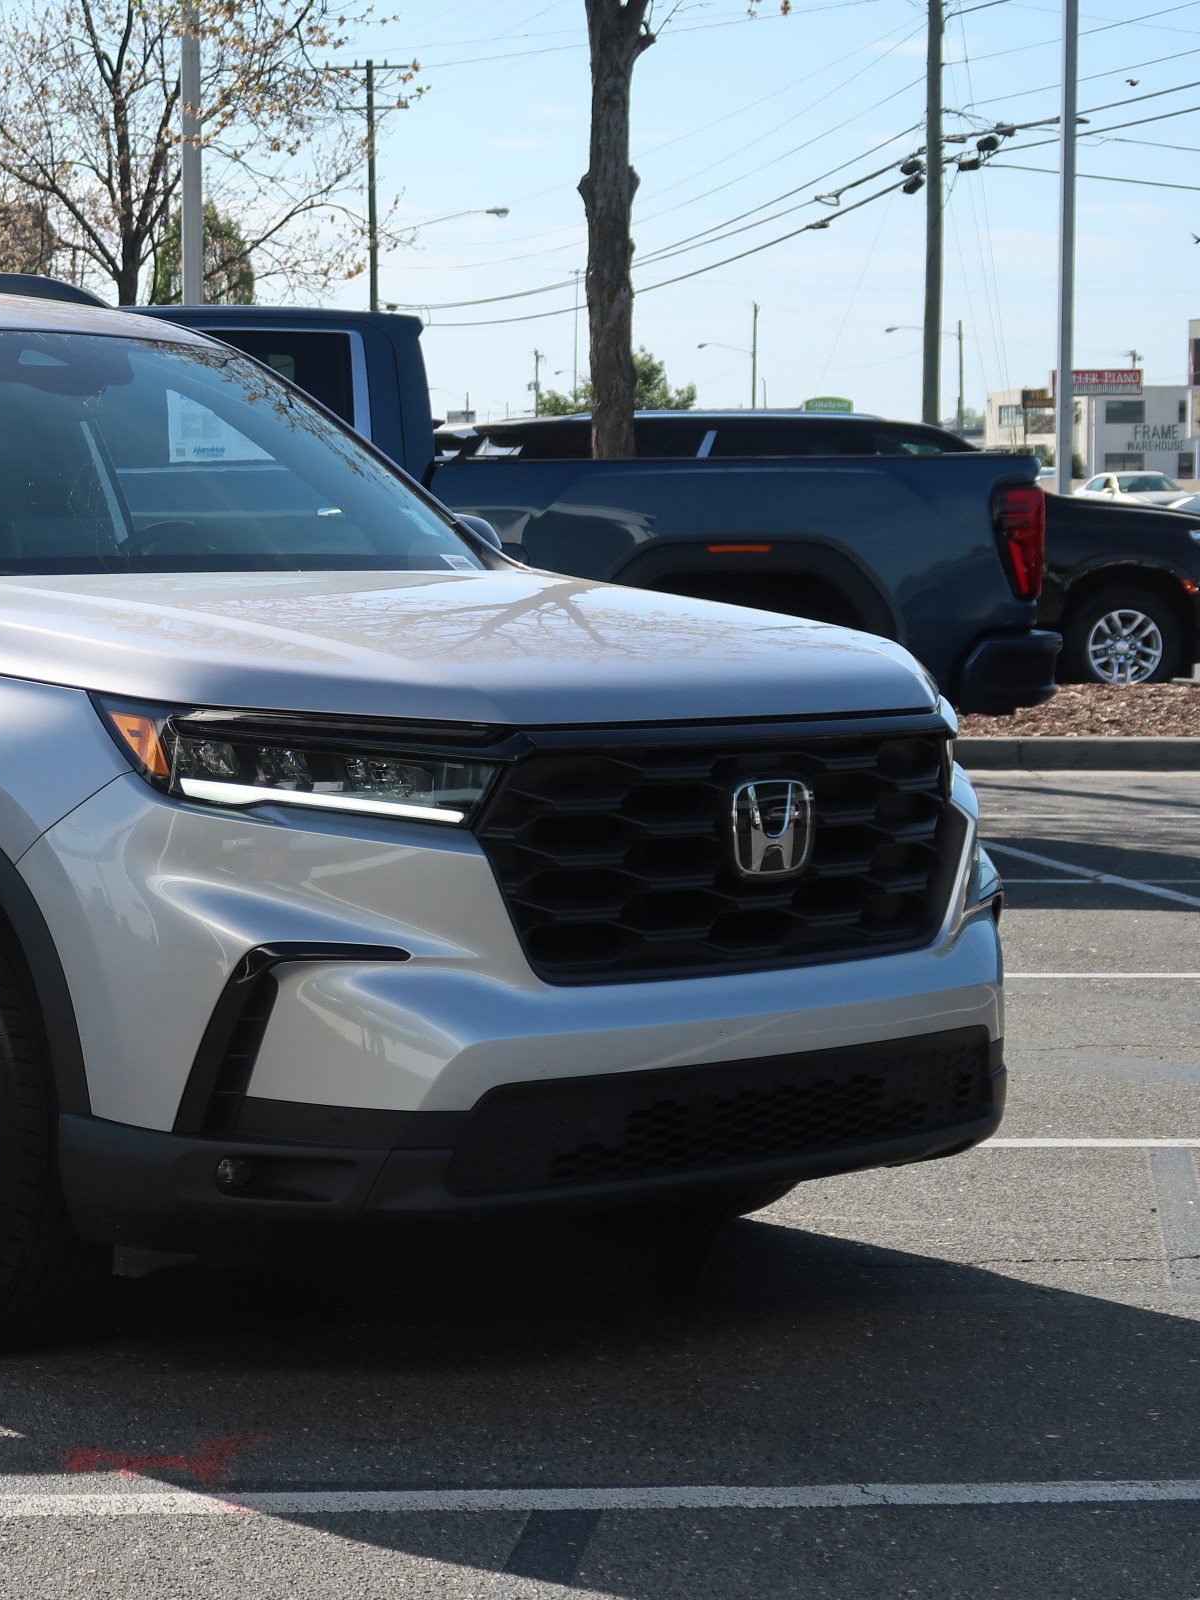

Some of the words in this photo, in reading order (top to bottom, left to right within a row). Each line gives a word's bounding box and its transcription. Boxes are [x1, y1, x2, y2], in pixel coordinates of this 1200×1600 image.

[1103, 371, 1140, 383] PIANO
[1134, 424, 1179, 440] FRAME
[1127, 440, 1185, 451] WAREHOUSE
